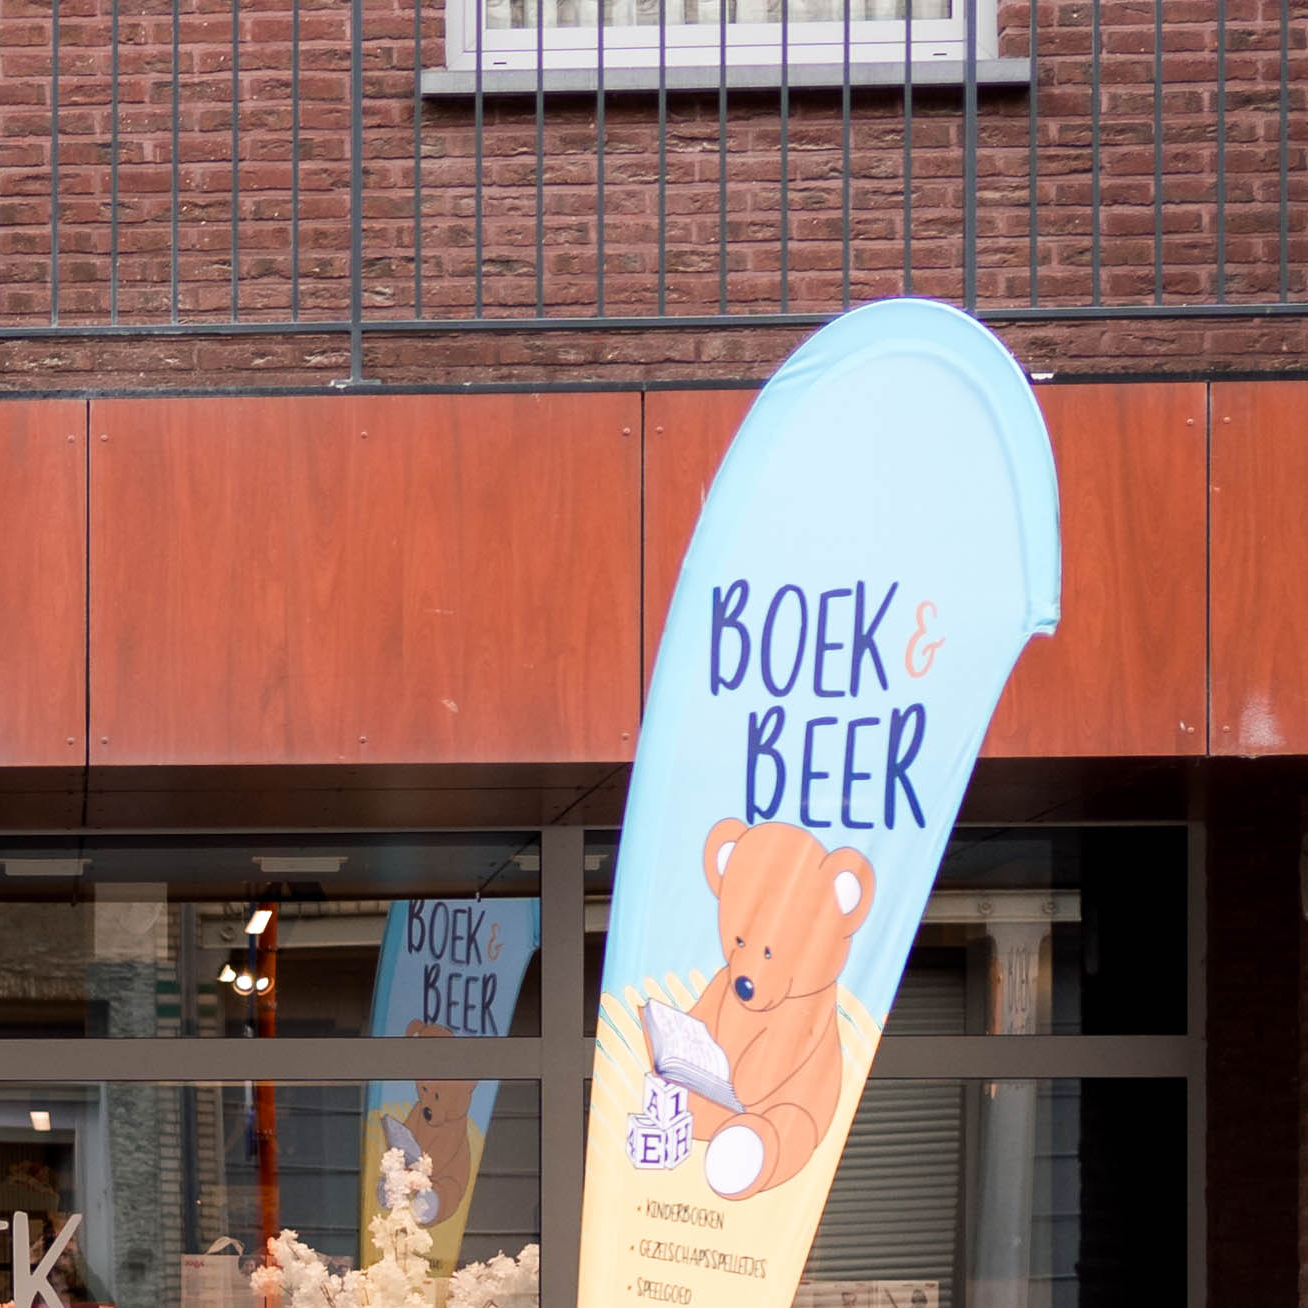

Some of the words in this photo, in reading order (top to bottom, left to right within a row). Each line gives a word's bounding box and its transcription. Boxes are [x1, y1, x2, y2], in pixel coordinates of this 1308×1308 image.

[710, 578, 899, 698] BOEK
[904, 600, 945, 678] &
[745, 702, 927, 830] BEER
[408, 899, 485, 965] BOEK
[424, 963, 499, 1036] BEER
[646, 1199, 725, 1230] KINDERBOEKEN
[636, 1276, 692, 1306] SPEELGOED
